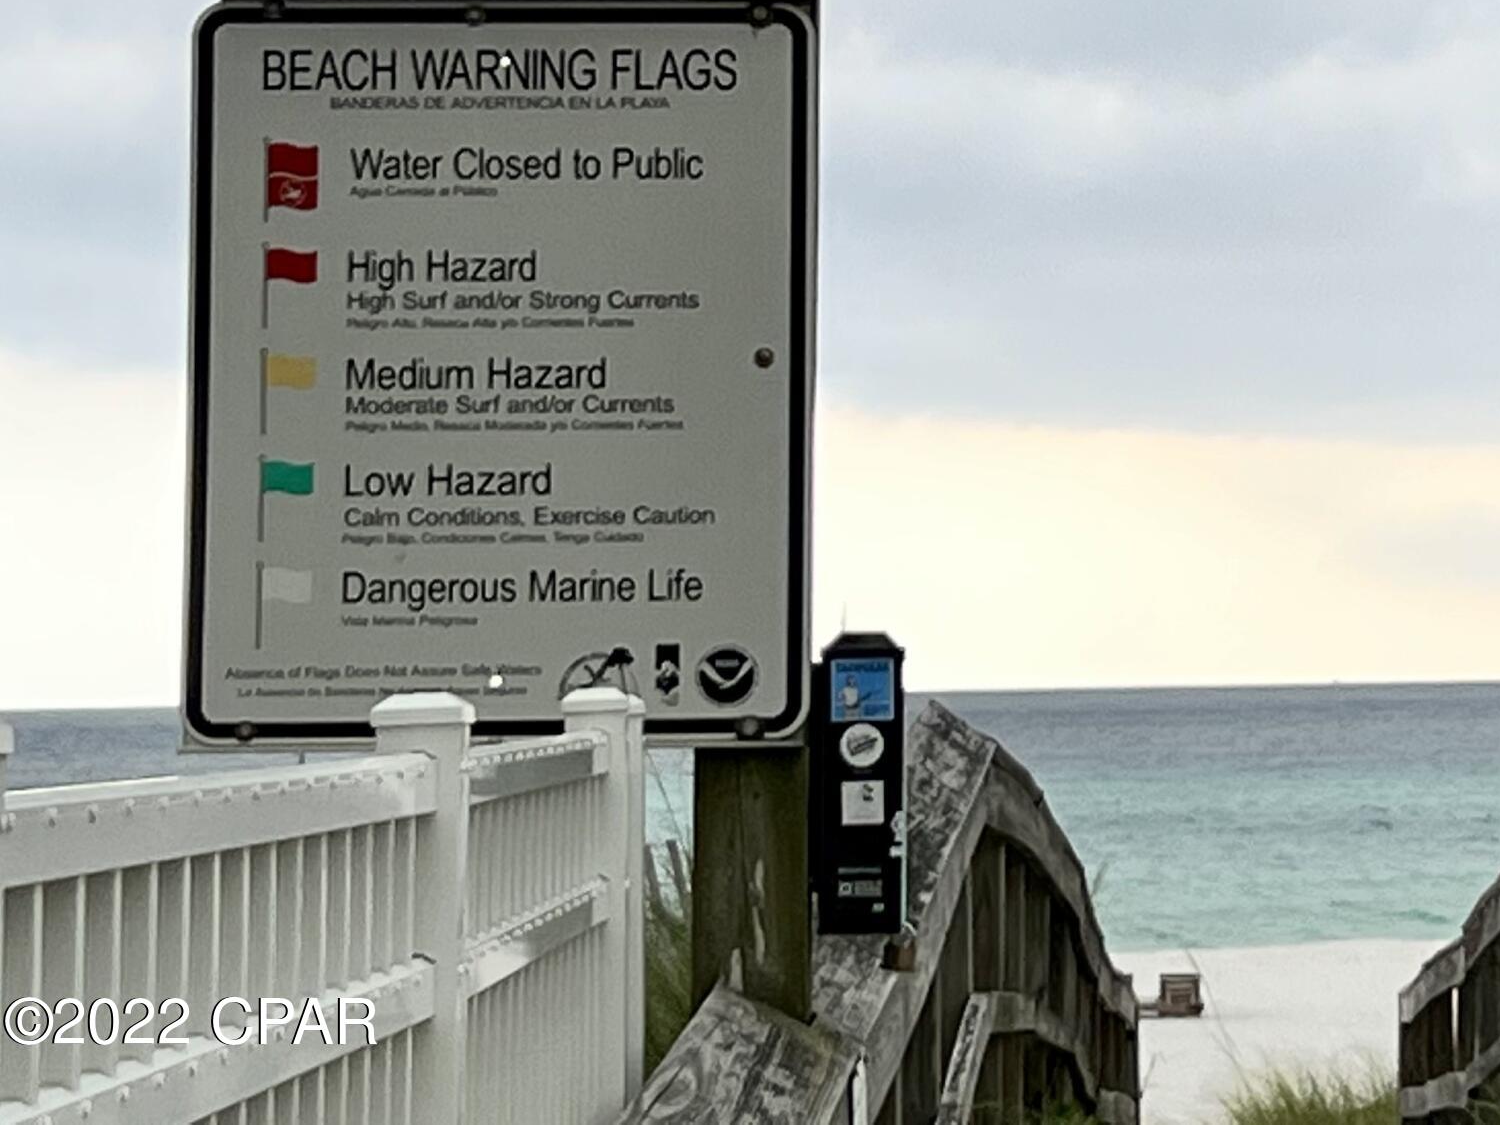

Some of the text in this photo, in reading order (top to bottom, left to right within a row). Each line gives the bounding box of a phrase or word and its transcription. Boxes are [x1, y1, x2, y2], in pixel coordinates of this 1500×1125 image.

[262, 48, 739, 91] BEACH WARNING FLAGS
[330, 96, 671, 110] BANDERAS DE ADVERTENCIA EN LA PLAYA
[350, 147, 704, 180] Water Closed to Public
[347, 249, 537, 289] High Hazard
[346, 289, 700, 313] High Surf and/or Strong Currents
[346, 357, 606, 389] Medium Hazard
[345, 395, 675, 414] Moderate Surf and/or Currents
[344, 463, 552, 496] Low Hazard
[344, 506, 400, 526] Calm
[533, 506, 625, 526] Exercise
[633, 506, 715, 526] Caution
[341, 568, 703, 612] Dangerous Marine Life
